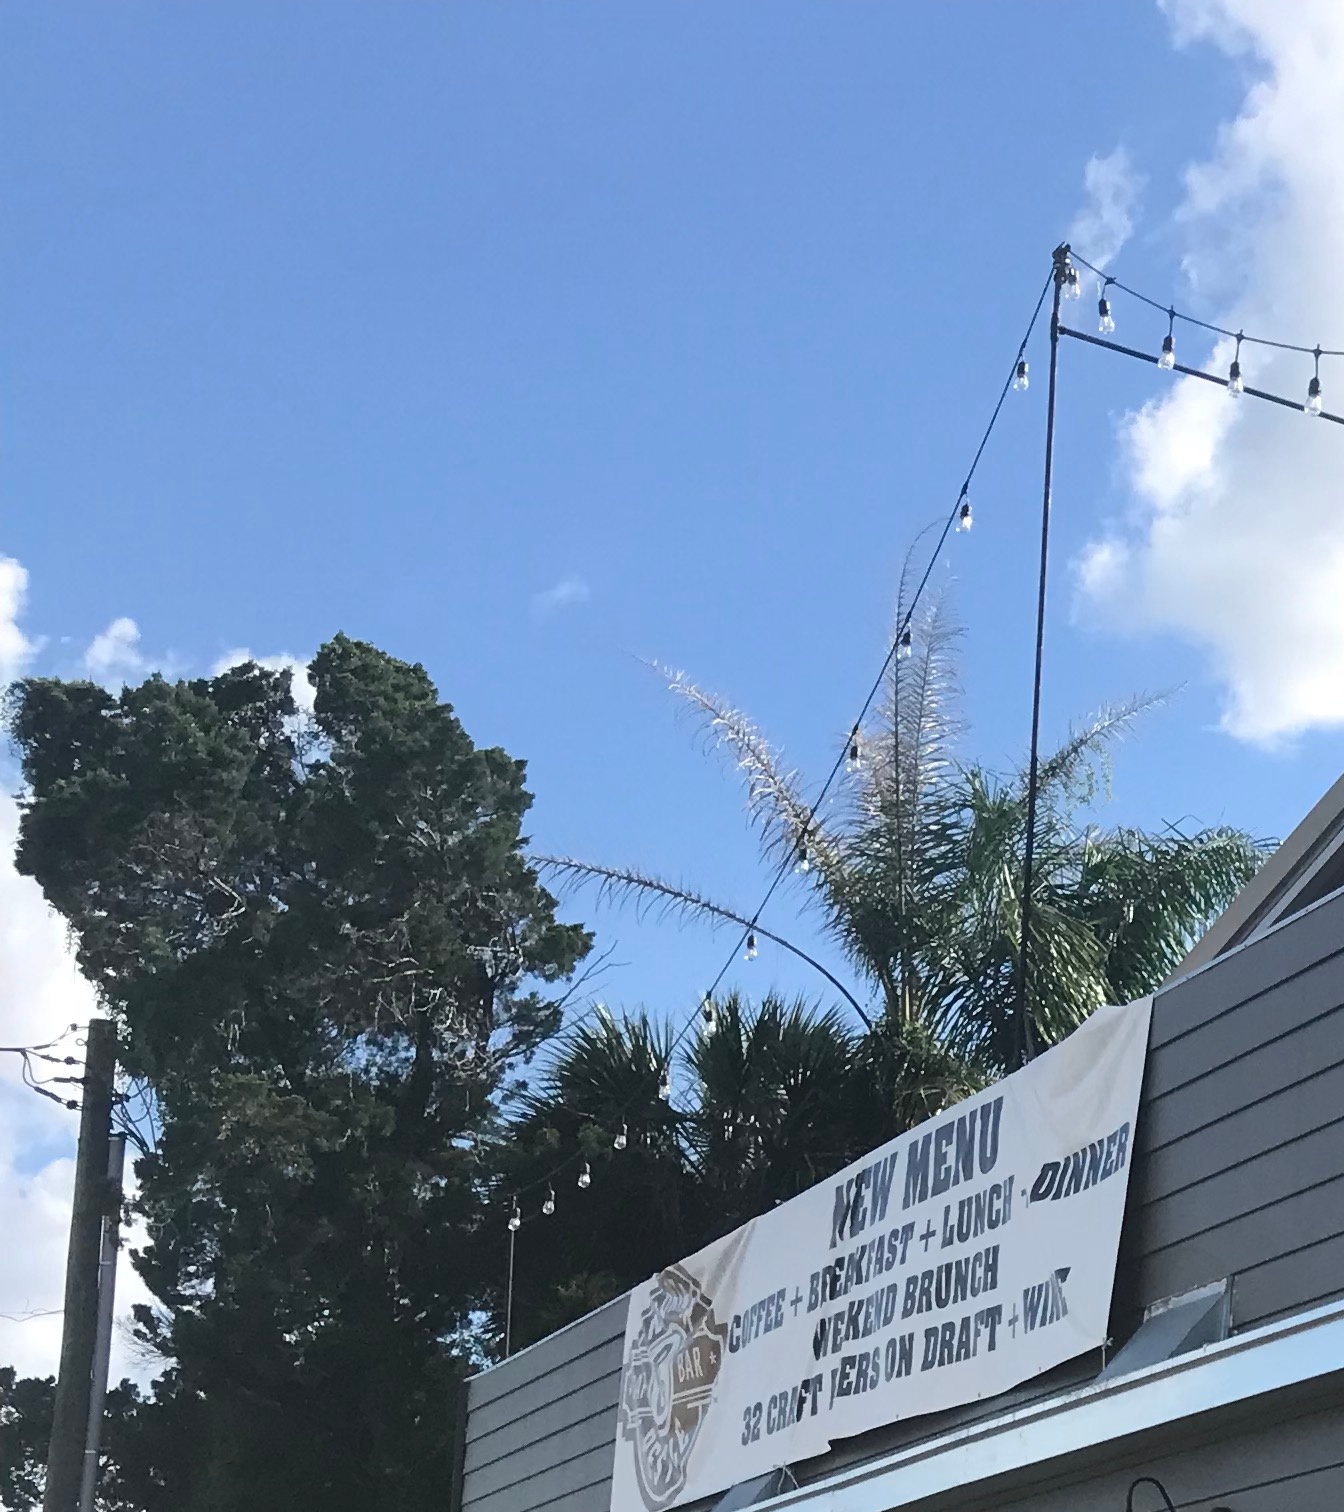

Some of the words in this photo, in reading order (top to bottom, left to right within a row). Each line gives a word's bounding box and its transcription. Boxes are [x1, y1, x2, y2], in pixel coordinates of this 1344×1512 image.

[728, 1287, 786, 1353] COFFEE
[941, 1174, 1015, 1249] LUNCH
[1029, 1121, 1130, 1204] DINNER
[829, 1151, 898, 1249] NEW
[902, 1096, 1004, 1210] MENU
[901, 1244, 1000, 1320] BRUNCH
[676, 1346, 704, 1384] BAR
[741, 1401, 763, 1446] 32
[884, 1332, 914, 1382] ON
[920, 1303, 1003, 1372] DRAFT
